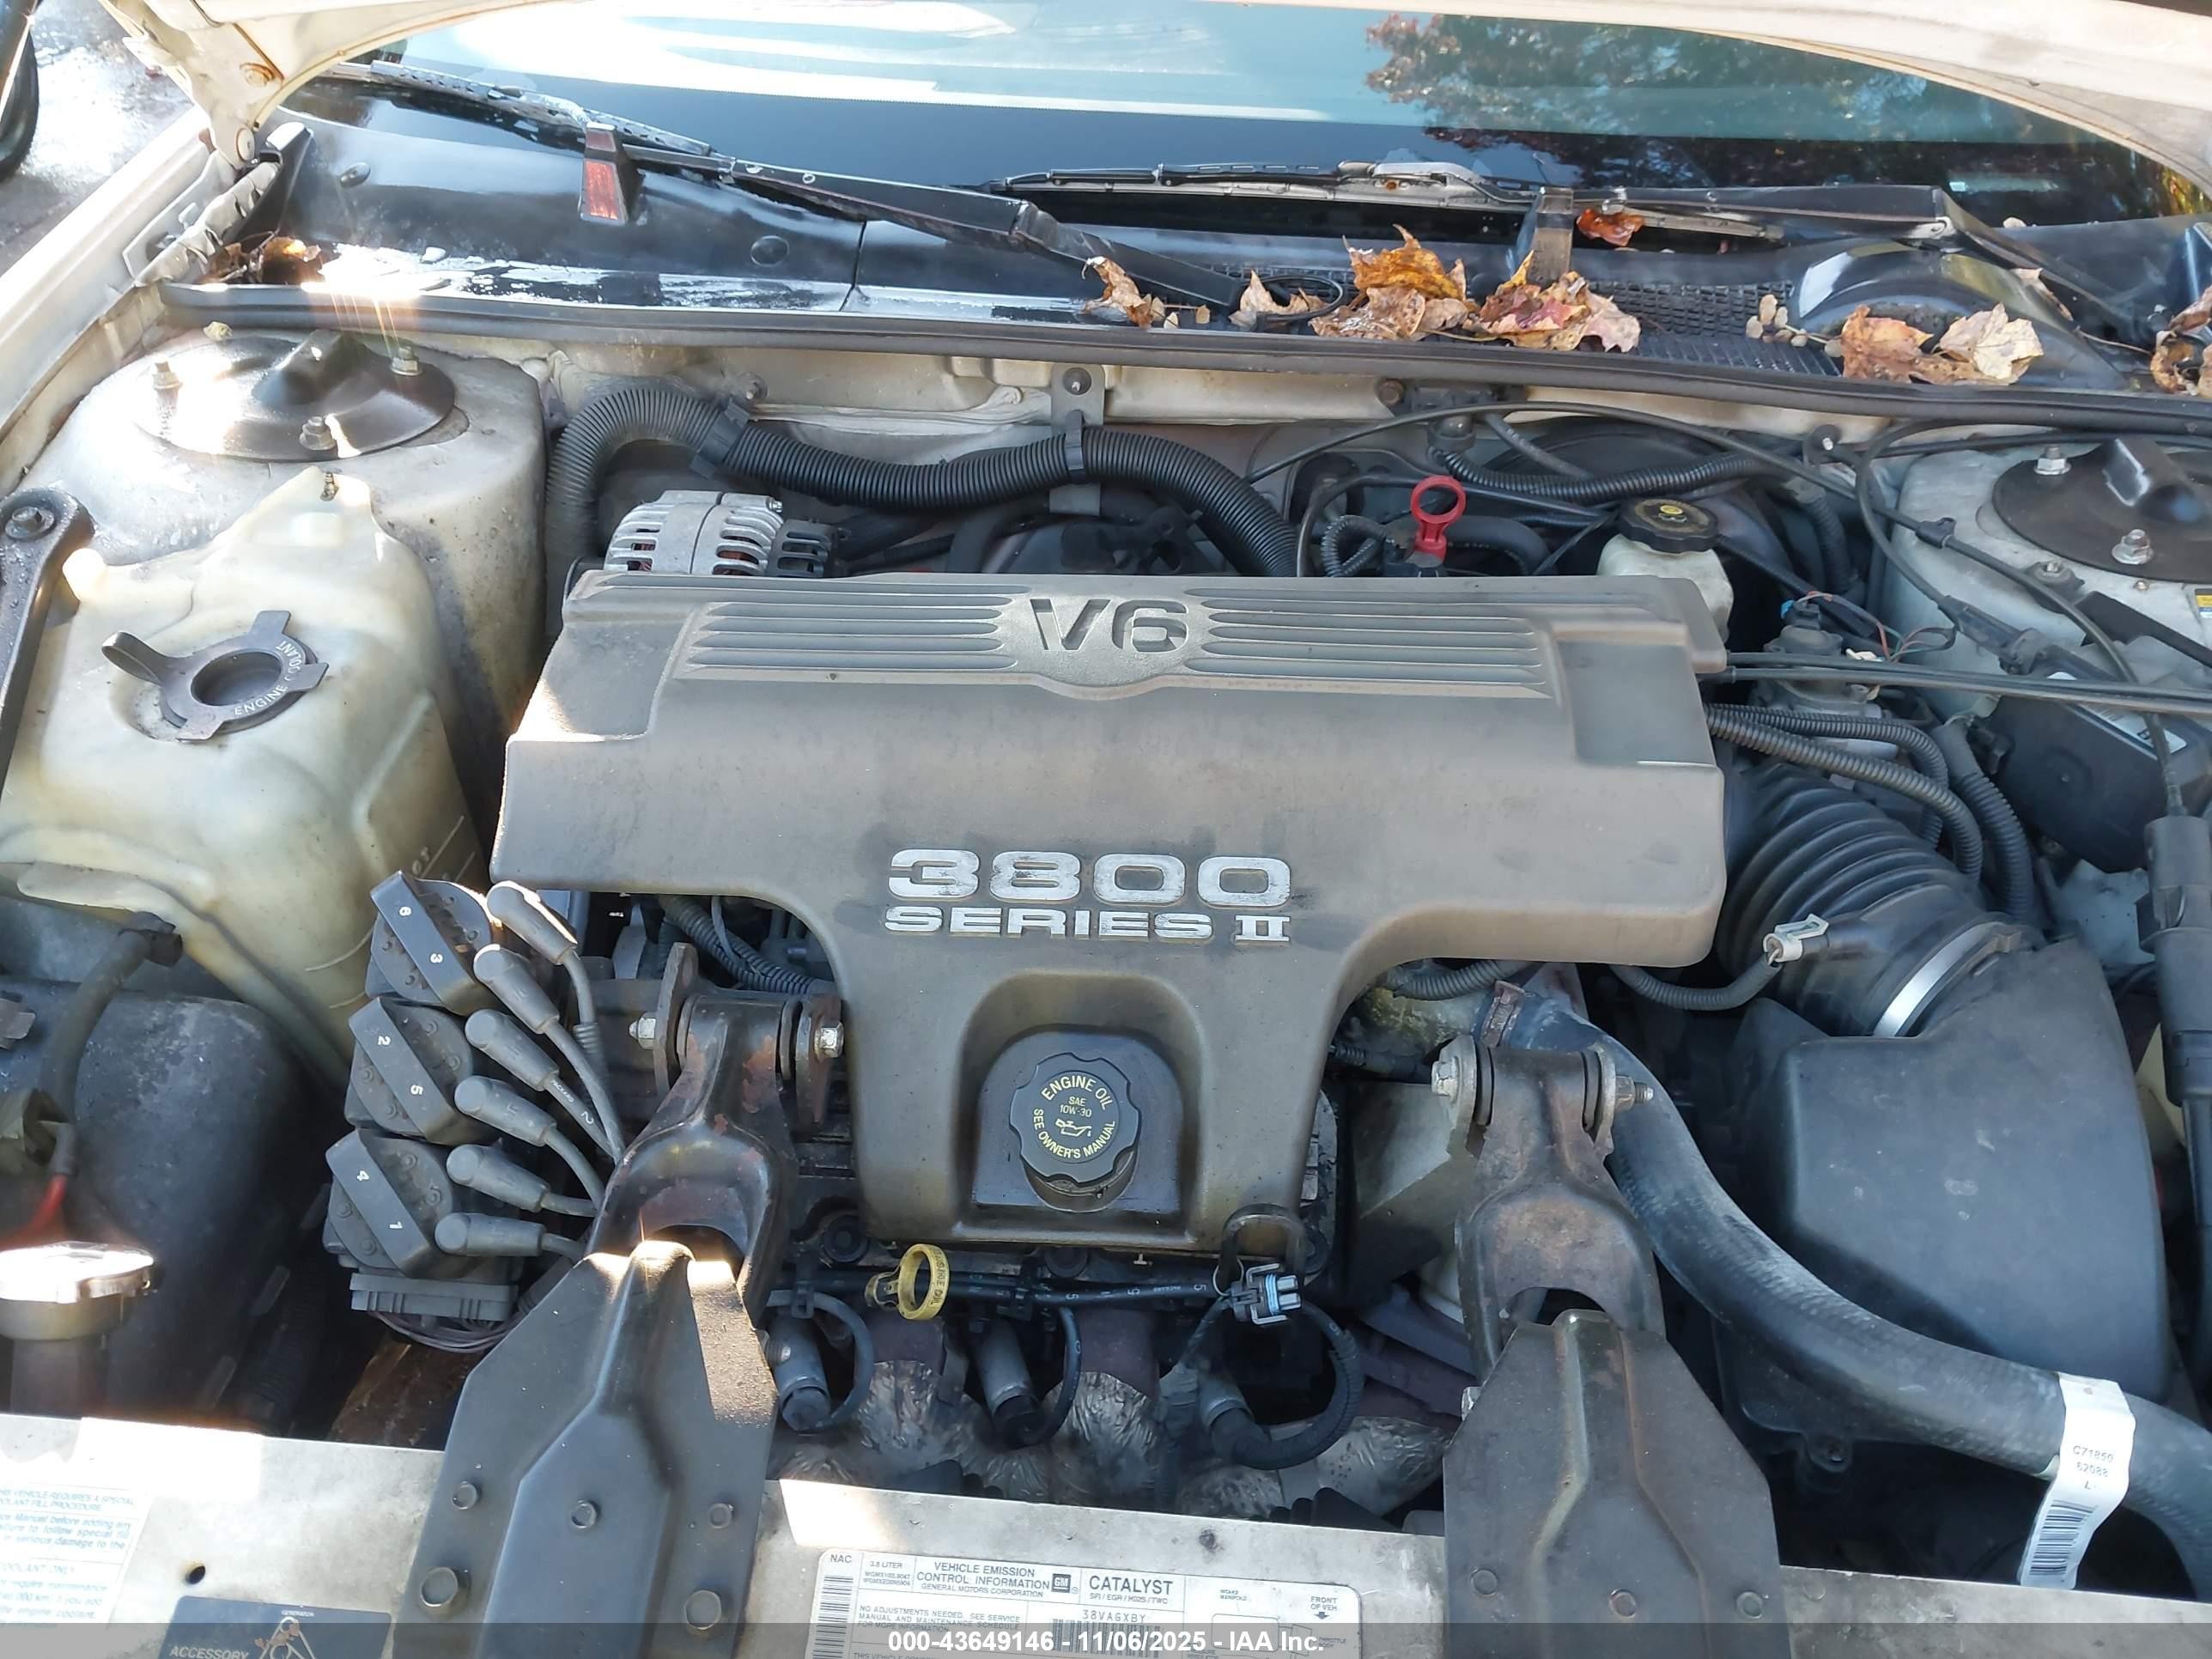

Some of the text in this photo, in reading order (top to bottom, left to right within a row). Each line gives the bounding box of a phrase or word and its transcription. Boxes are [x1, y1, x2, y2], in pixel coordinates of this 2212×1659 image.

[1030, 599, 1188, 653] V6
[234, 684, 288, 715] ENGINE
[888, 848, 1291, 907] 3800
[884, 906, 1291, 942] SERIES II
[429, 953, 443, 963] 3
[377, 1036, 392, 1046] 2
[410, 1084, 423, 1095] 5
[1041, 1075, 1114, 1110] ENGINE OIL
[1068, 1096, 1086, 1107] SAE
[580, 1110, 595, 1125] 2
[1059, 1104, 1092, 1118] 10W-30
[1033, 1108, 1115, 1159] SEE OWNER'S MANUAL
[356, 1170, 370, 1182] 4
[389, 1221, 403, 1230] 1
[830, 1553, 853, 1565] NAC
[934, 1561, 1036, 1578] VEHICLE EMISSION
[916, 1571, 1050, 1590] CONTROL INFORMATION
[1089, 1575, 1173, 1595] CATALYST
[921, 1583, 1044, 1599] GENERAL MOTORS CORPORATION
[1310, 1595, 1338, 1605] FRONT
[859, 1613, 1019, 1630] MANUAL AND MAINTENANCE SCHEDULE
[873, 1606, 929, 1616] ADJUSTMENTS
[988, 1614, 1020, 1623] SERVICE
[875, 1621, 896, 1630] MORE
